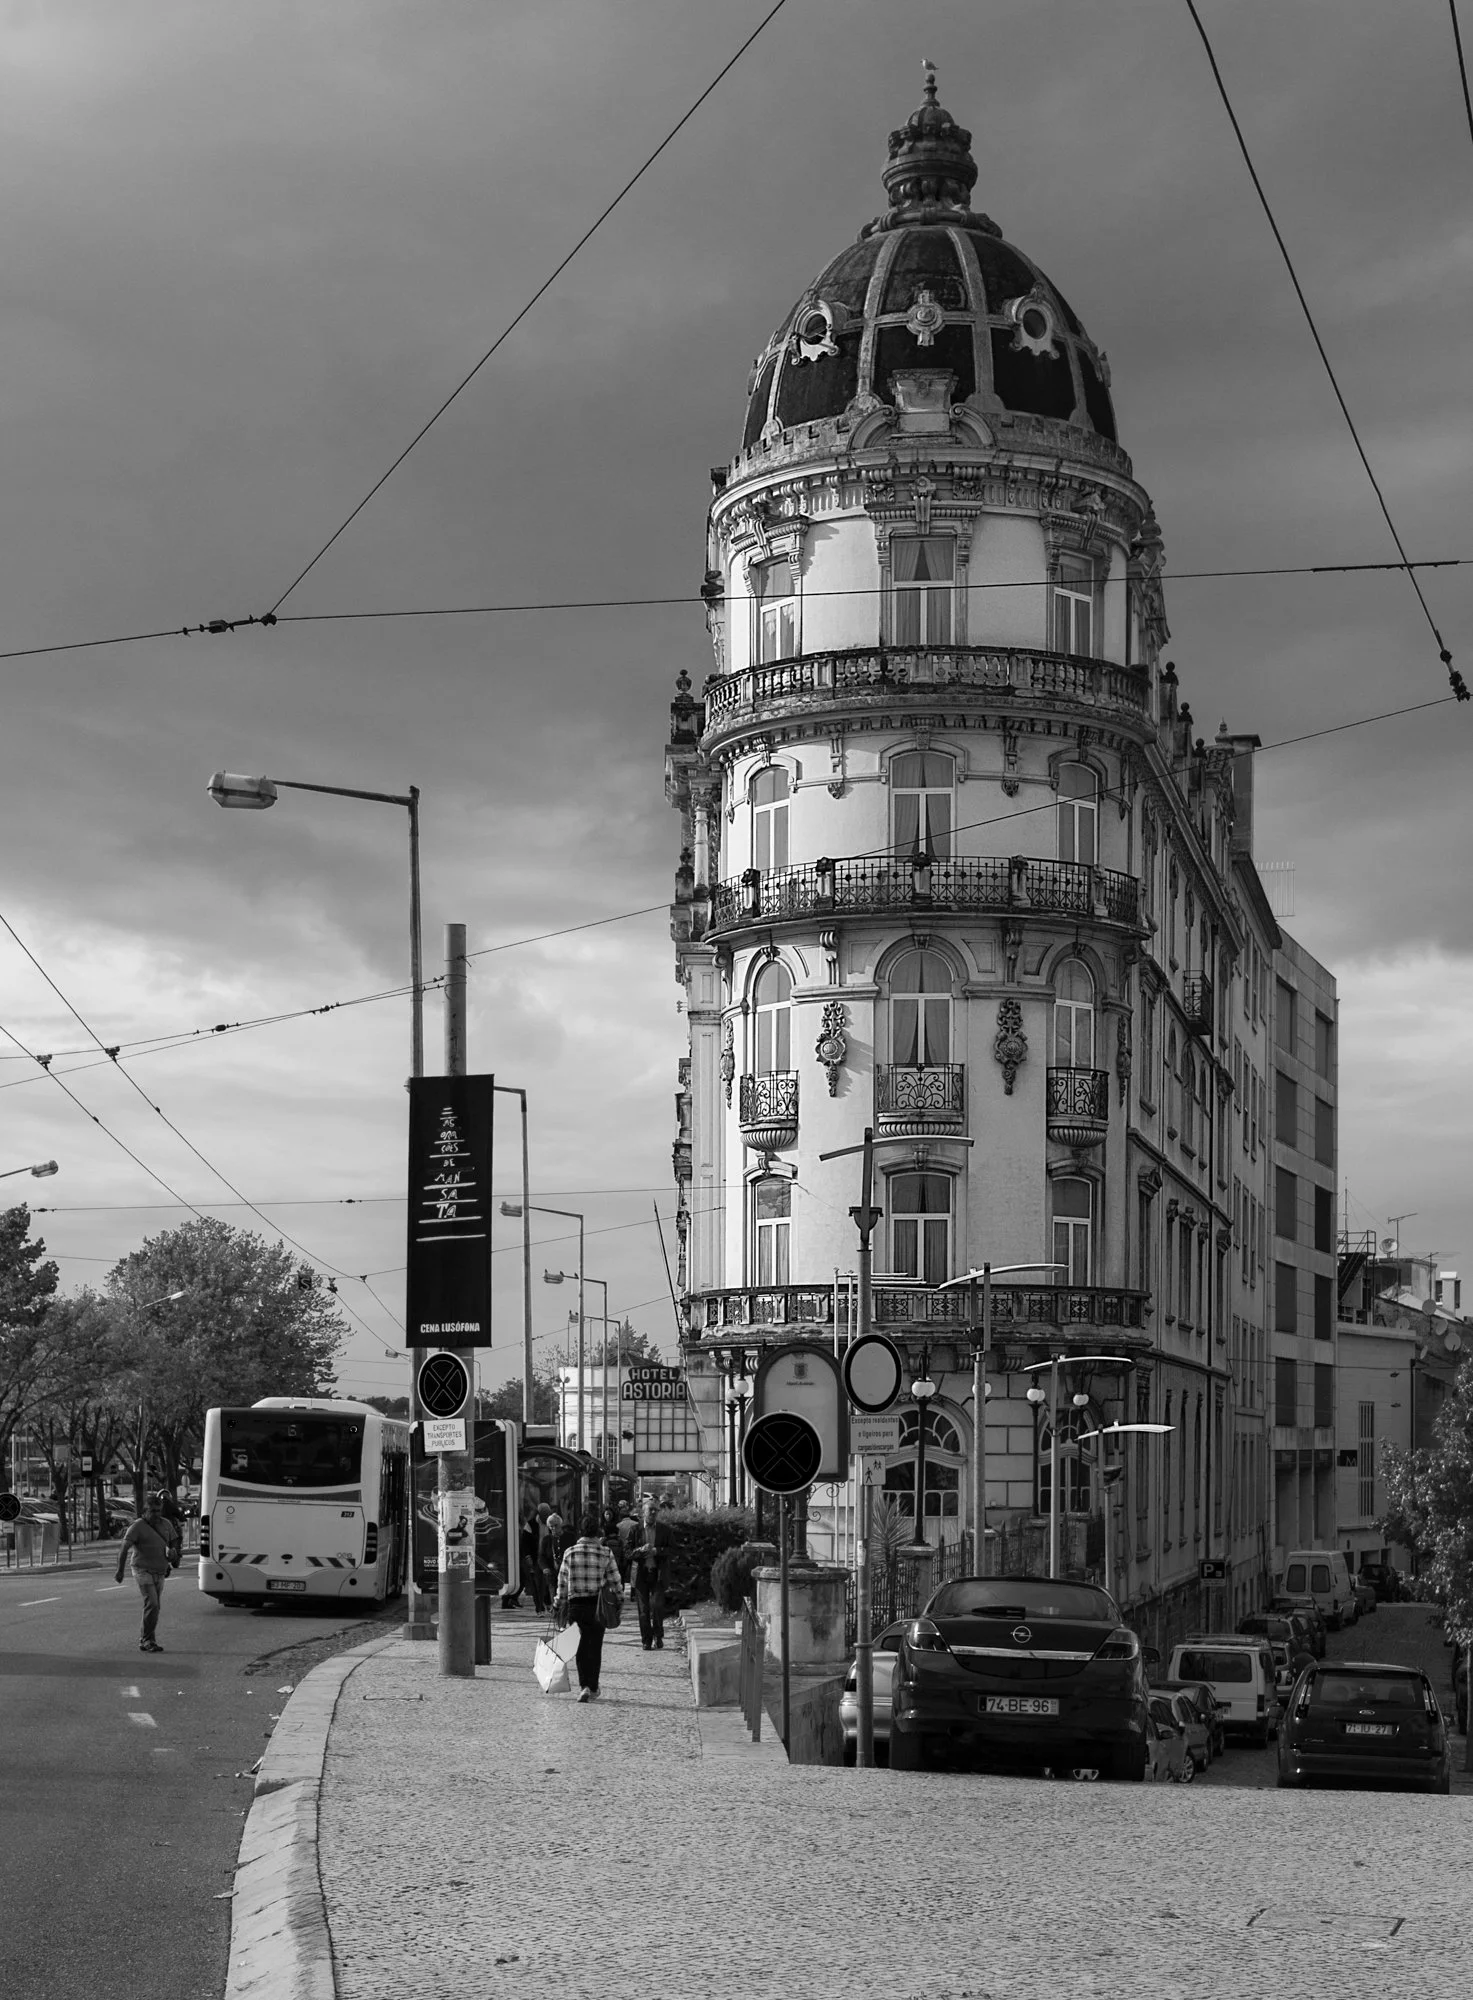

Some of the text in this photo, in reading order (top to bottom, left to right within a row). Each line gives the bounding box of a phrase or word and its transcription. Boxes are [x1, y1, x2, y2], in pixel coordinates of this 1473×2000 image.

[443, 1158, 455, 1167] DE
[434, 1171, 461, 1184] MAN
[439, 1188, 458, 1201] SA
[420, 1321, 480, 1333] CENA LUSÓFONA
[632, 1368, 677, 1380] HOTEL
[623, 1382, 686, 1399] ASTORIA
[427, 1431, 462, 1439] TRANSPORTES
[1203, 1564, 1215, 1577] P
[988, 1698, 1049, 1712] 74-BE-96
